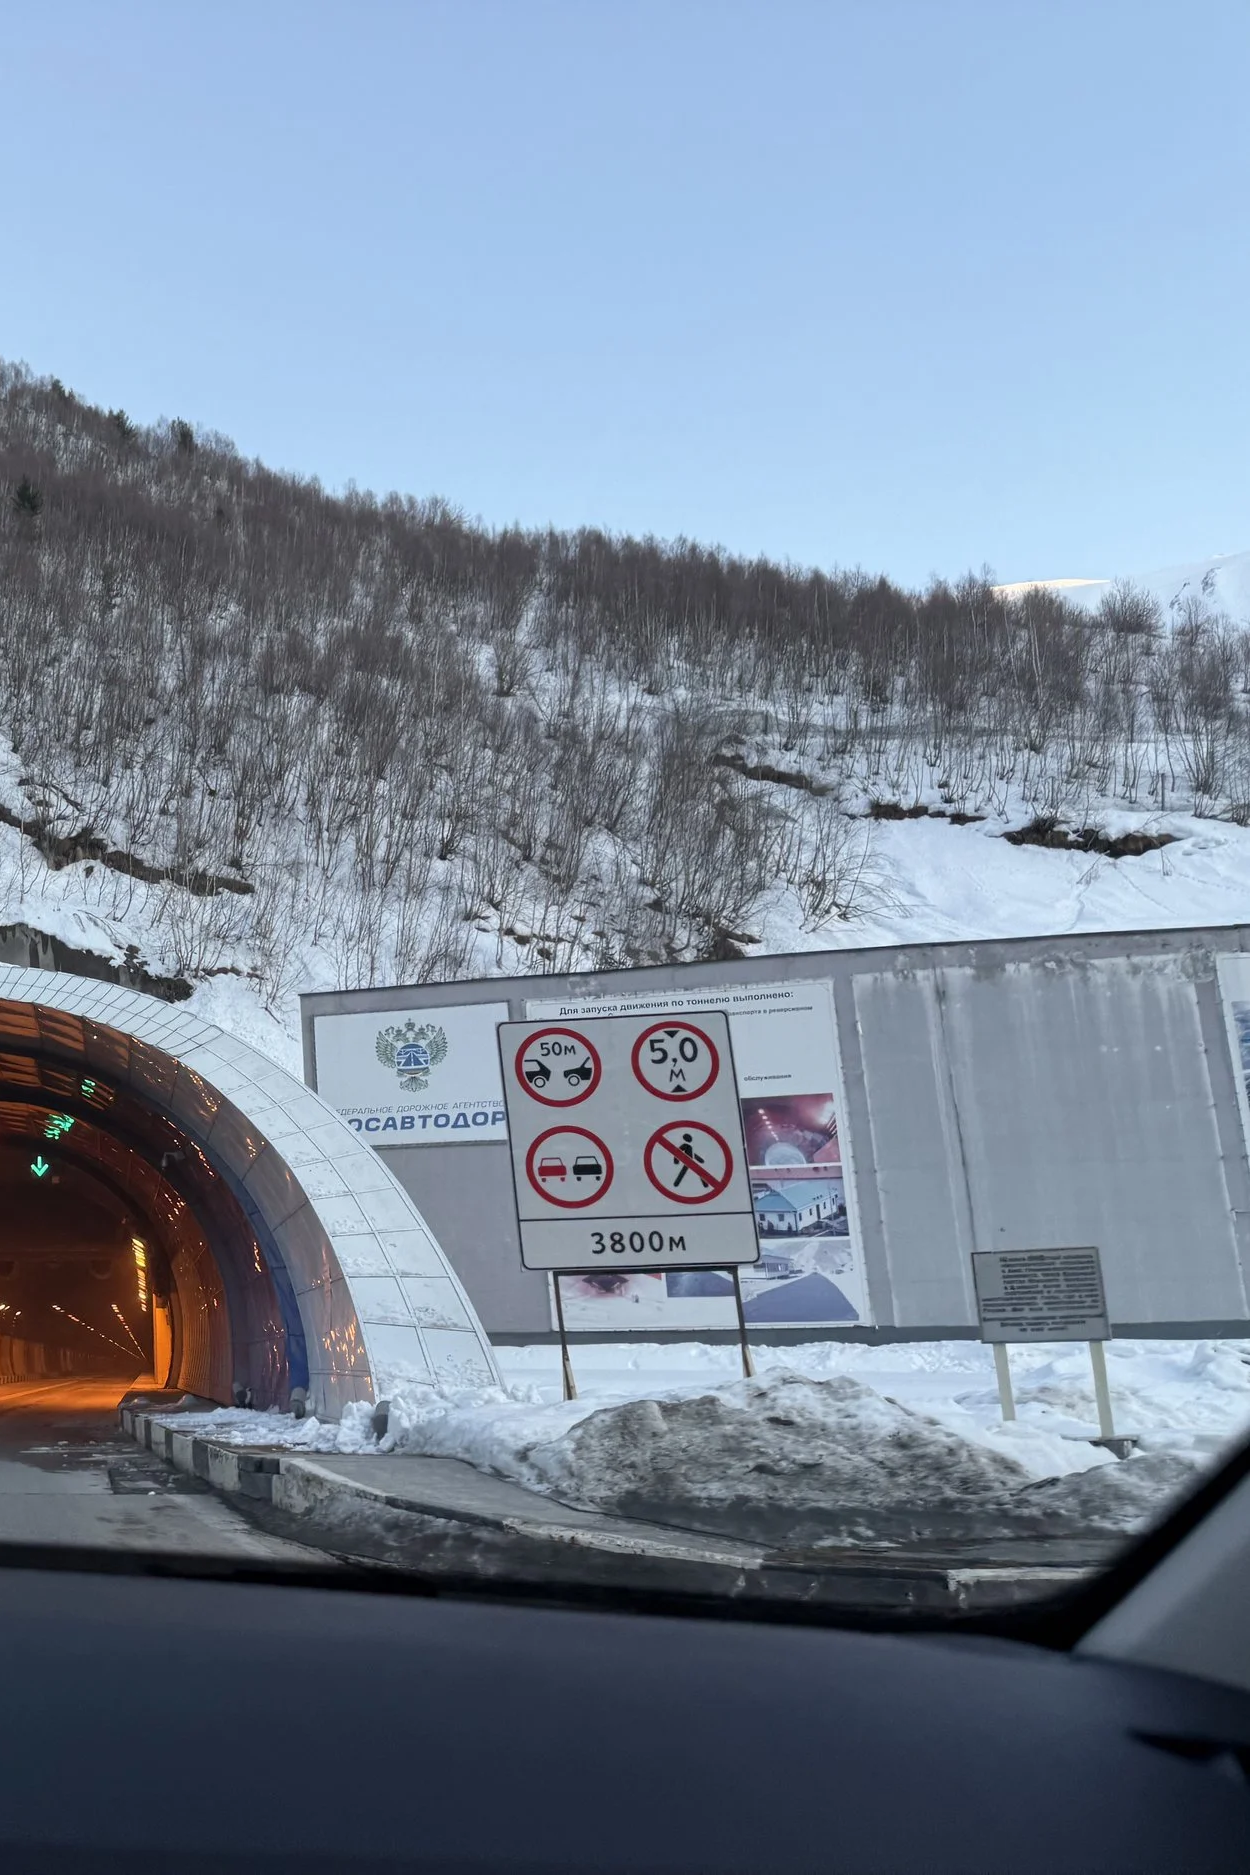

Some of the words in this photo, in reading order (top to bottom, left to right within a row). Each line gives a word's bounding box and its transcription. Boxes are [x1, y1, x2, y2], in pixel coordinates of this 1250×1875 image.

[559, 1007, 579, 1016] Для
[581, 1004, 618, 1015] запуска
[620, 1001, 669, 1011] движения
[686, 996, 730, 1006] тоннелю
[733, 991, 794, 1003] выполнено:
[649, 1037, 698, 1067] 5,0
[396, 1102, 449, 1114] ДОРОЖНОЕ
[347, 1110, 506, 1133] ОСАВТОДОР
